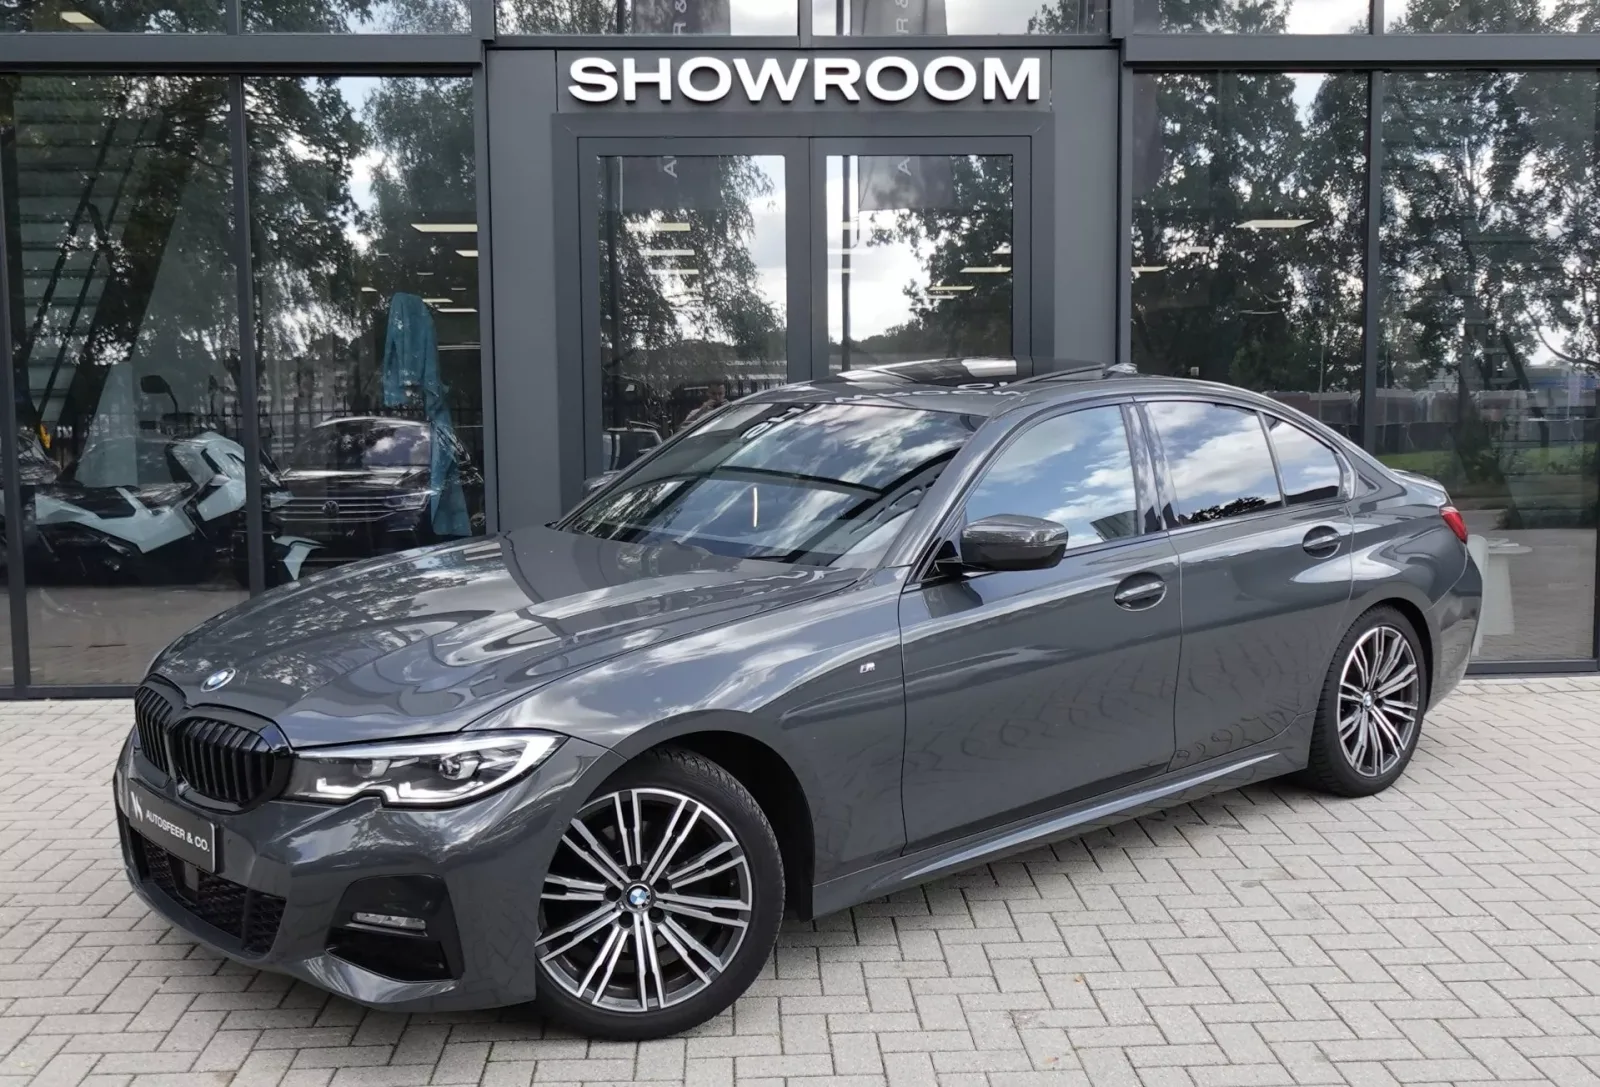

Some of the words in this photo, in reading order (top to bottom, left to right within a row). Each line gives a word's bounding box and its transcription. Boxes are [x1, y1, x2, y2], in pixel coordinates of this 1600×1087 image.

[567, 56, 1041, 102] SHOWROOM
[145, 809, 186, 841] AUTOSFEER
[186, 832, 194, 845] &
[194, 836, 210, 852] CO.
